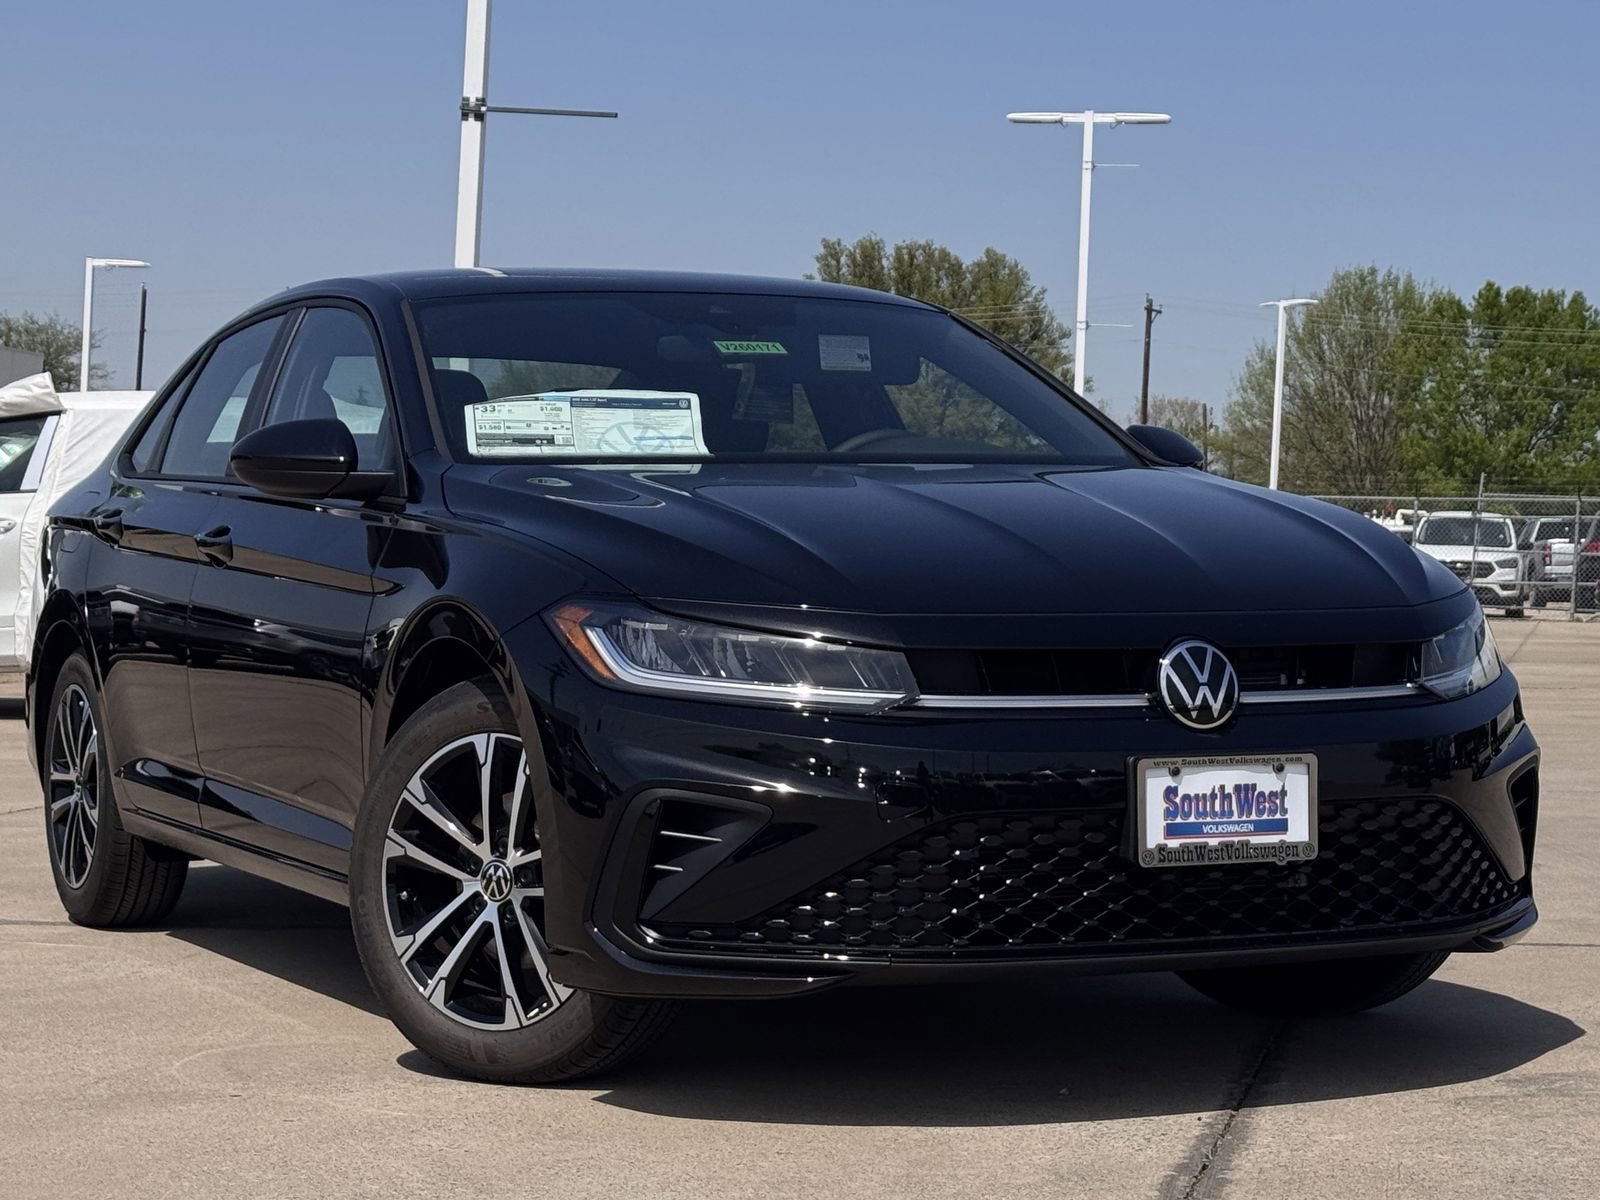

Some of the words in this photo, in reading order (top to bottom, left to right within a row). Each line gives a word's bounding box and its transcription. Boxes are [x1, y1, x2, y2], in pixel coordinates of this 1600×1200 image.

[718, 343, 781, 352] V260171
[1202, 823, 1254, 833] VOLKSWAGEN
[1158, 843, 1299, 863] SouthWestVolkswagen
